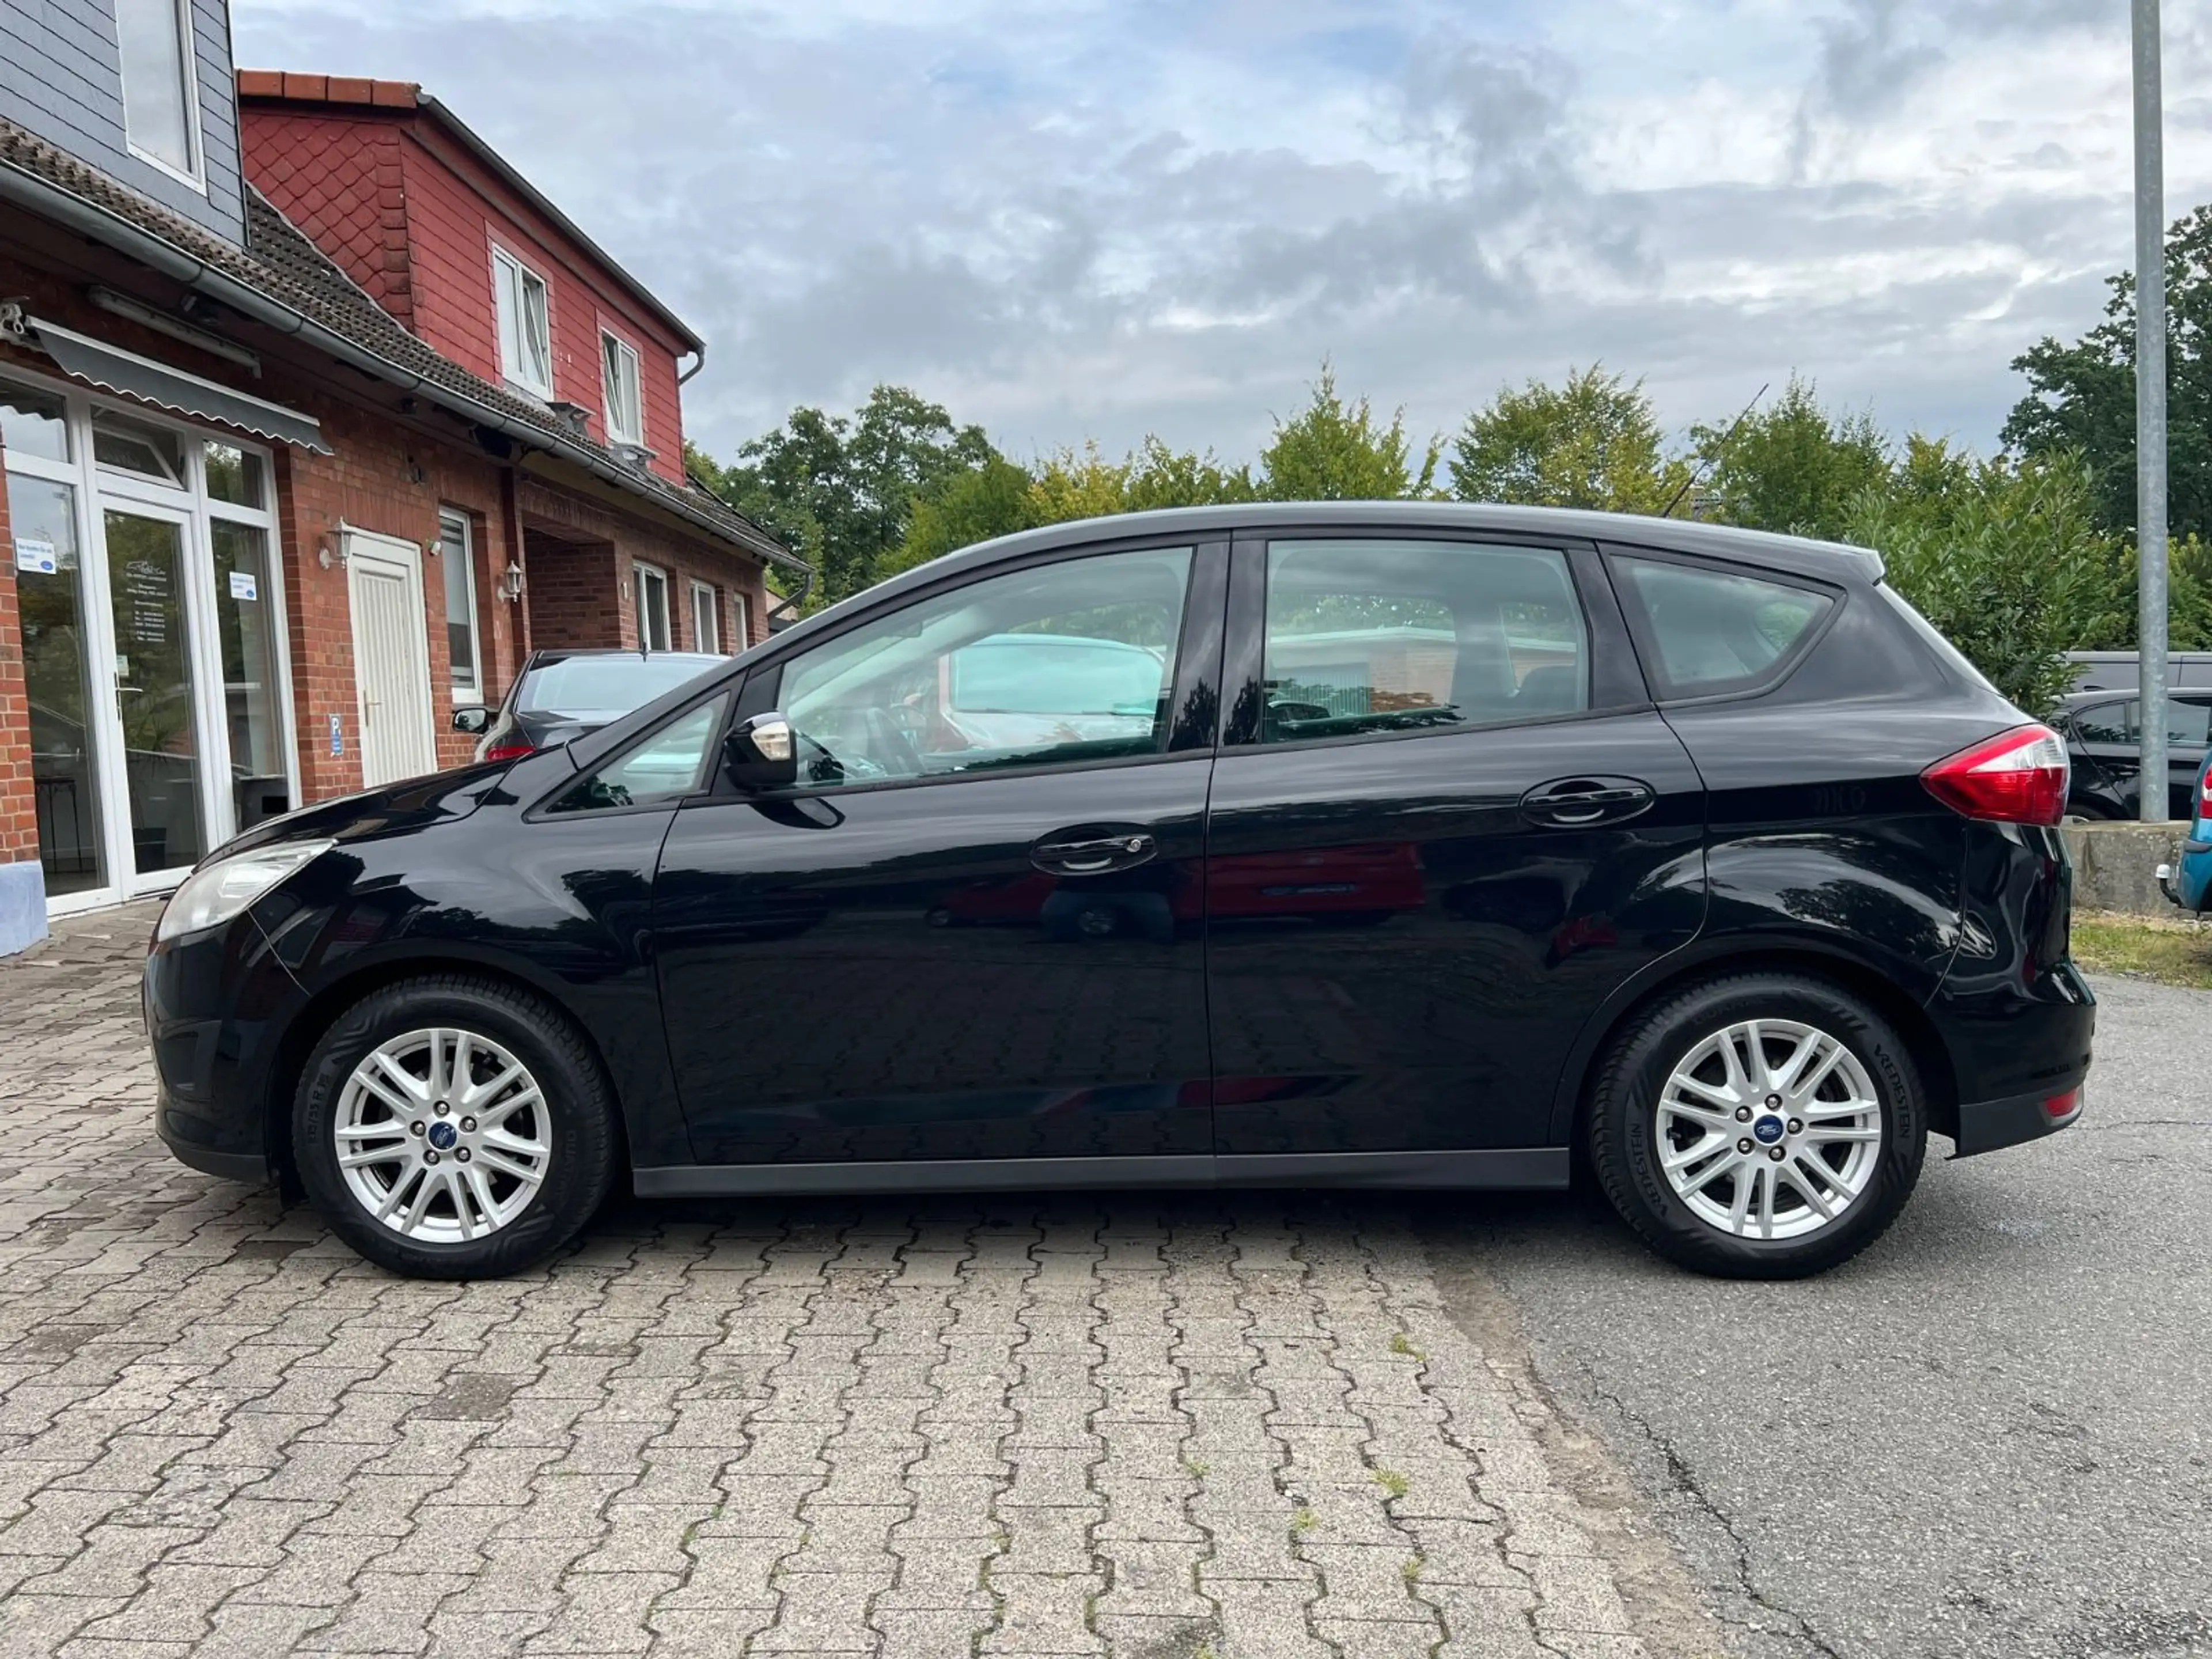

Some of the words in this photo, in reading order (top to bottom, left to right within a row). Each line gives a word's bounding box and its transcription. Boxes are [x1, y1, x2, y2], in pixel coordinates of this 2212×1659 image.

[331, 717, 339, 734] P
[1874, 1043, 1910, 1138] VREDESTEIN
[1630, 1123, 1668, 1217] VREDESTEIN
